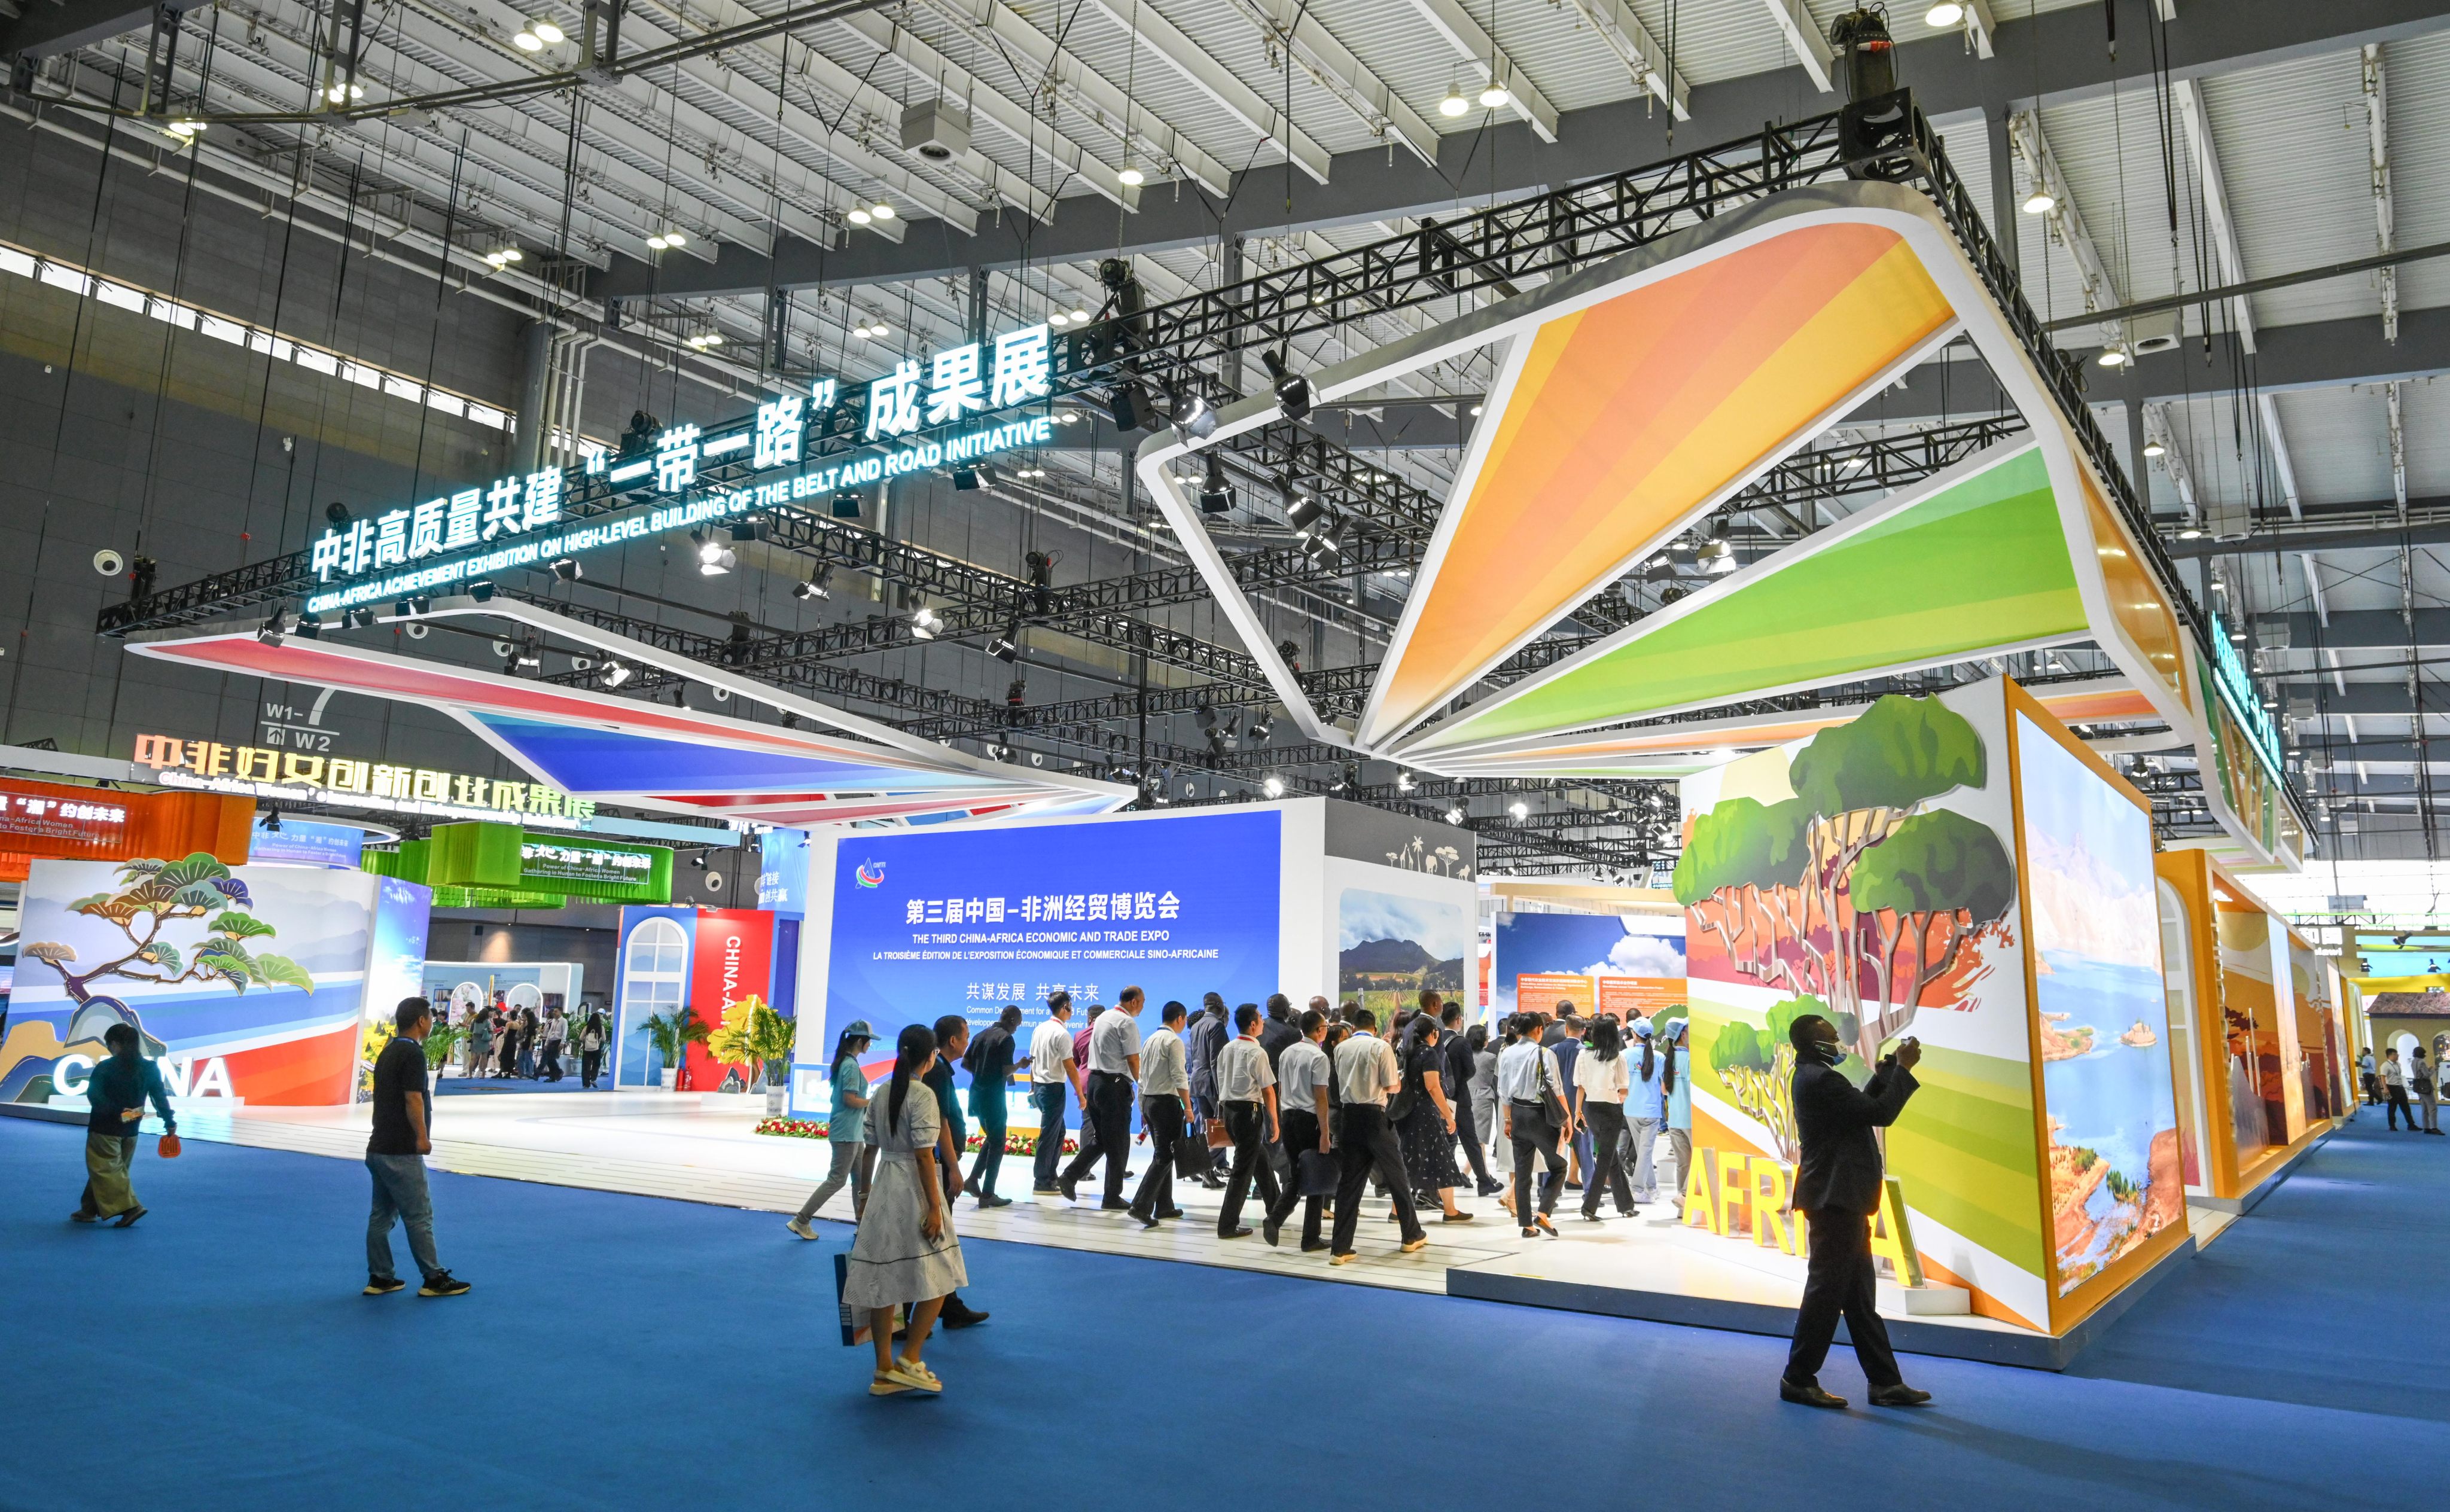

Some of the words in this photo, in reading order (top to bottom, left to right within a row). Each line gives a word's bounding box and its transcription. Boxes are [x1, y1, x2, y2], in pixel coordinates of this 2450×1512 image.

[311, 323, 1052, 582] 中非高质量共建“一带一路”成果展
[307, 580, 382, 613] CHINA-AFRICA
[383, 560, 466, 595] ACHIEVEMENT
[467, 543, 538, 576] EXHIBITION
[540, 537, 562, 558] ON
[563, 516, 650, 553] HIGH-LEVEL
[650, 499, 726, 532] BUILDING
[729, 490, 754, 513] OF
[755, 481, 790, 507] THE
[793, 469, 838, 498] BELT
[840, 458, 881, 487] AND
[885, 444, 941, 476] ROAD
[946, 416, 1050, 461] INITIATIVE
[10, 824, 38, 832] Foster
[46, 828, 71, 836] Bright
[43, 819, 73, 828] Women
[912, 934, 929, 944] THE
[931, 934, 957, 944] THIRD
[959, 933, 1023, 943] CHINA-AFRICA
[1026, 932, 1077, 943] ECONOMIC
[1080, 931, 1101, 942] AND
[1104, 931, 1138, 941] TRADE
[1141, 930, 1169, 941] EXPO
[873, 952, 882, 960] LA
[883, 950, 921, 960] TROISIÈME
[922, 949, 950, 960] ÉDITION
[952, 951, 962, 960] DE
[1016, 949, 1069, 960] ÉCONOMIQUE
[1071, 950, 1081, 959] ET
[1084, 950, 1145, 959] COMMERCIALE
[1148, 949, 1218, 959] SINO-AFRICAINE
[720, 936, 741, 1025] CHINA-A
[966, 982, 1025, 1001] 共谋发展
[995, 1006, 1035, 1015] Dement
[53, 1054, 233, 1097] CNA
[1683, 1147, 1911, 1287] AFRIA
